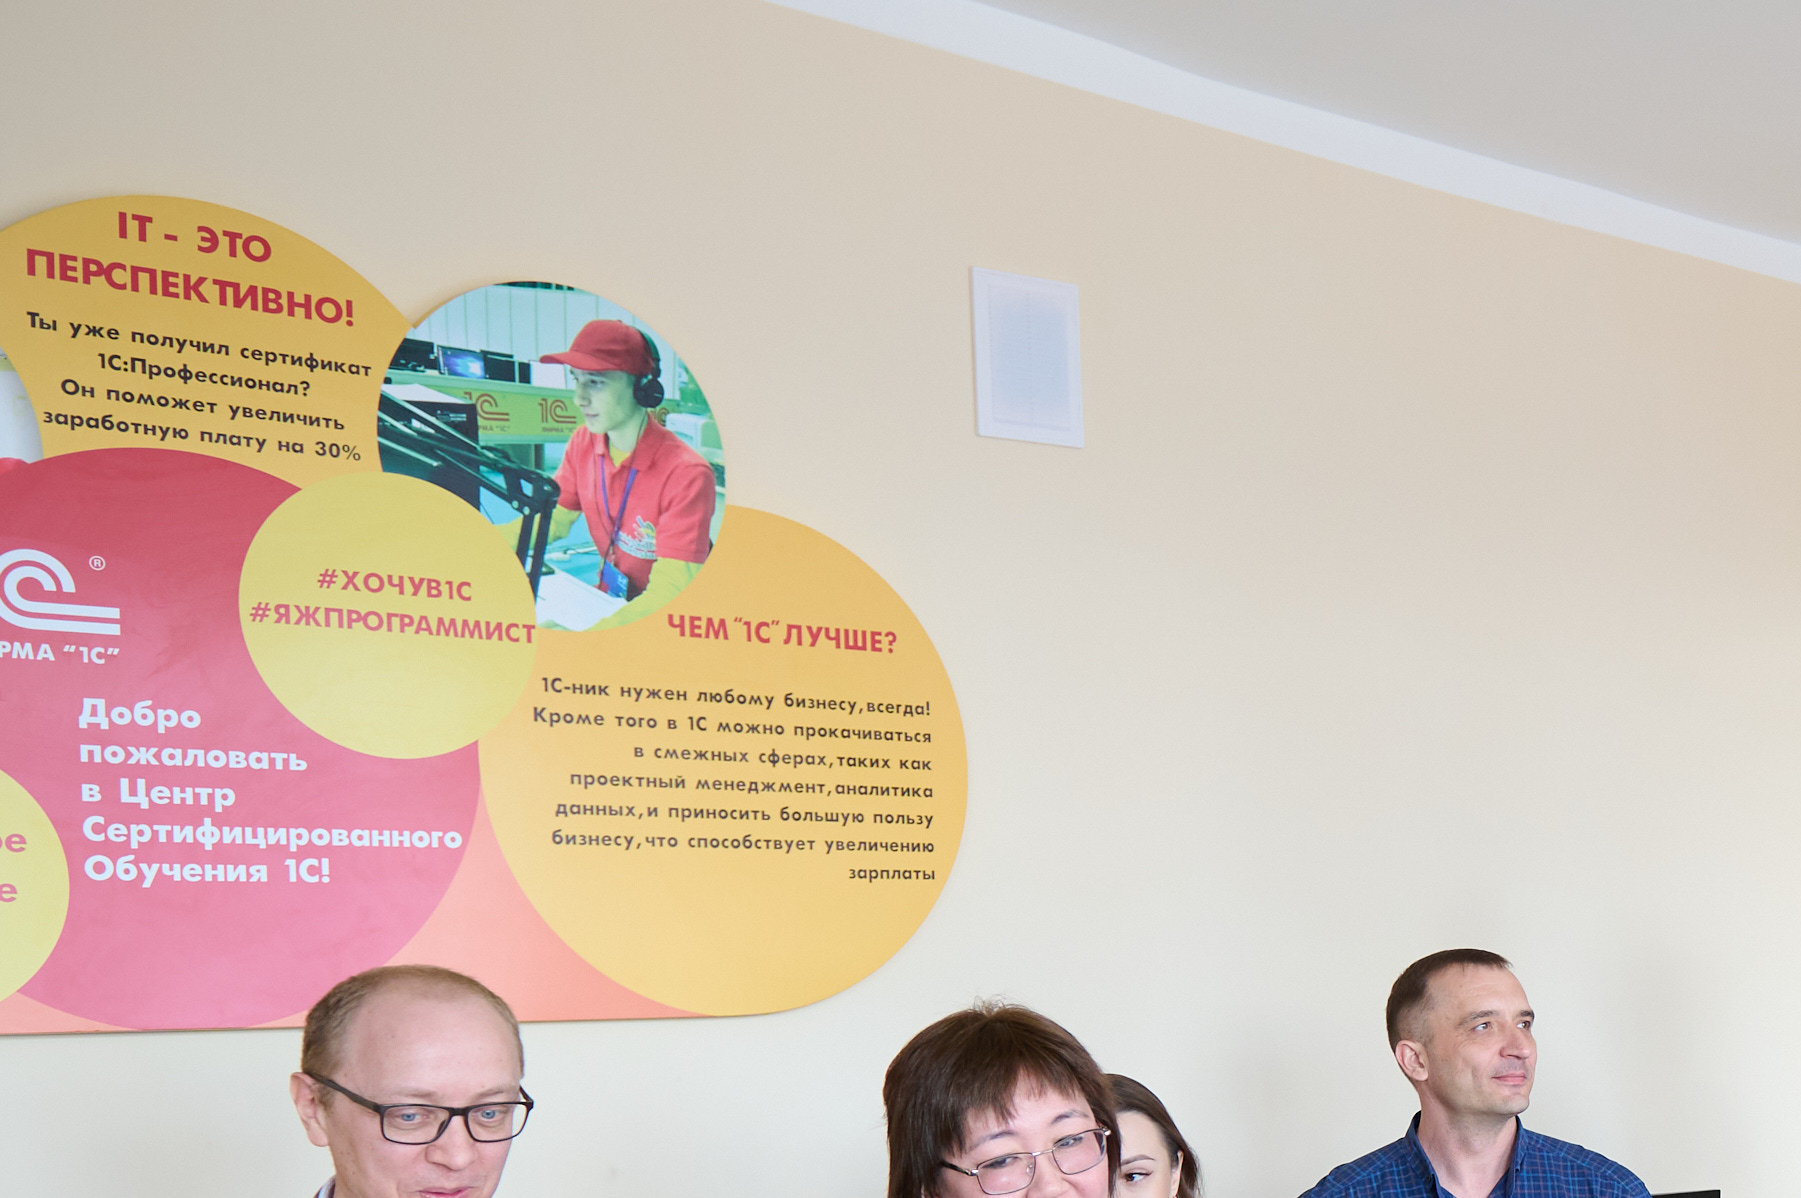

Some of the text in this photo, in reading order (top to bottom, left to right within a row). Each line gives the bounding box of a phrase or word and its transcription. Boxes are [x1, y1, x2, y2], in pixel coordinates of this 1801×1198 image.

[118, 211, 153, 243] IT
[197, 225, 272, 263] ЭТО
[26, 248, 354, 327] ПЕРСПЕКТИВНО!
[26, 311, 372, 377] Ты уже получил сертификат
[97, 353, 311, 397] 1С:Профессионал?
[60, 378, 345, 431] Он поможет увеличить
[42, 410, 361, 461] заработную плату на 30%
[317, 568, 473, 602] #ХОЧУВ1С
[249, 601, 536, 645] #ЯЖПРОГРАММИСТ
[667, 613, 729, 641] ЧЕМ
[784, 623, 898, 654] ЛУЧШЕ?
[541, 676, 611, 698] 1С-ник
[620, 686, 688, 704] нужен
[697, 688, 775, 710] любому
[78, 697, 202, 734] Добро
[533, 707, 932, 744] Кроме того в 1С можно прокачиваться
[79, 744, 308, 772] пожаловать
[633, 745, 644, 759] в
[653, 745, 750, 764] смежных
[899, 757, 932, 771] как
[81, 778, 236, 812] в Центр
[570, 771, 686, 791] проектный
[82, 815, 463, 852] Сертифицированного
[668, 805, 771, 823] приносить
[780, 806, 865, 825] большую
[873, 811, 934, 830] пользу
[0, 833, 27, 853] е
[688, 834, 816, 853] способствует
[824, 838, 935, 855] увеличению
[84, 854, 331, 888] Обучения 1С!
[848, 866, 936, 884] зарплаты
